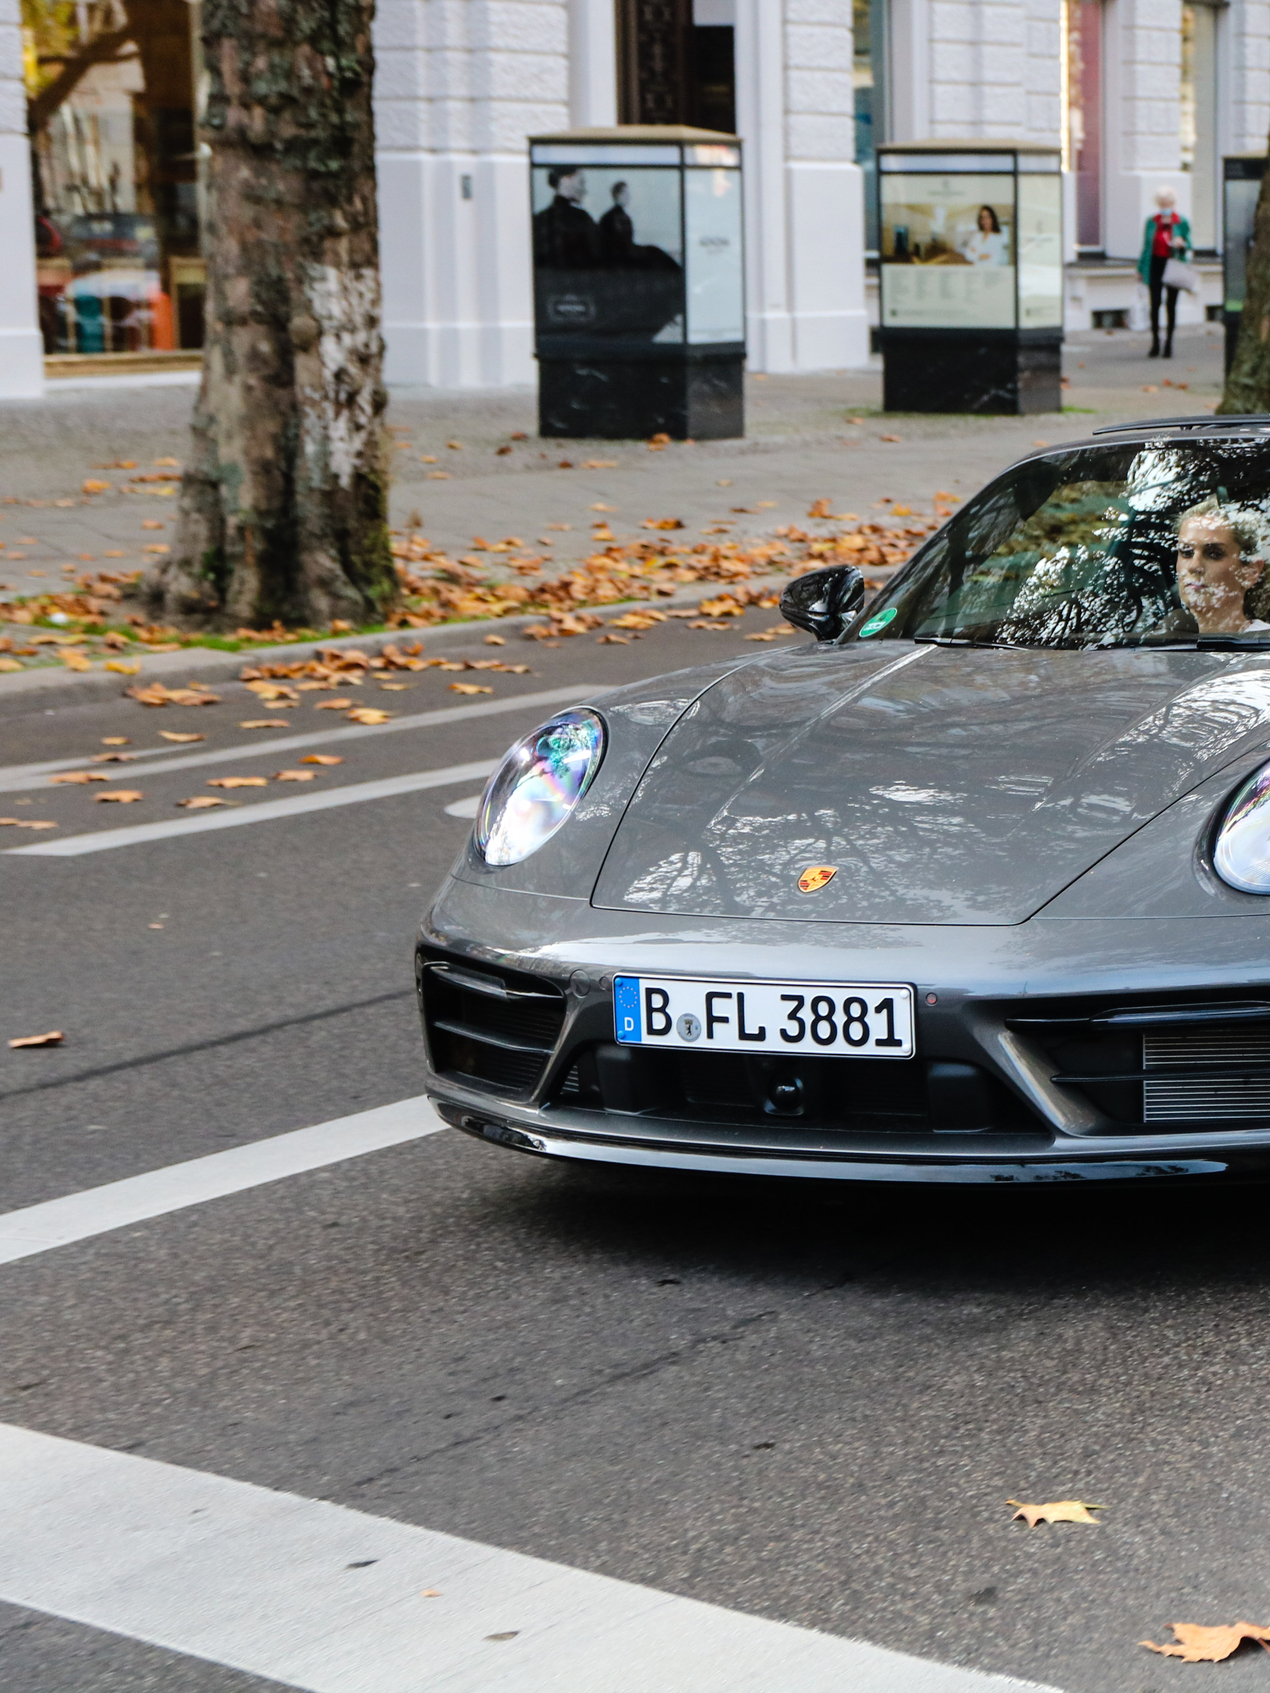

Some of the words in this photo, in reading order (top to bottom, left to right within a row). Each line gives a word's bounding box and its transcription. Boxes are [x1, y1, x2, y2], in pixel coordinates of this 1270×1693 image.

[624, 1017, 635, 1031] D
[645, 987, 673, 1036] B
[705, 991, 766, 1042] FL
[779, 994, 903, 1048] 3881
